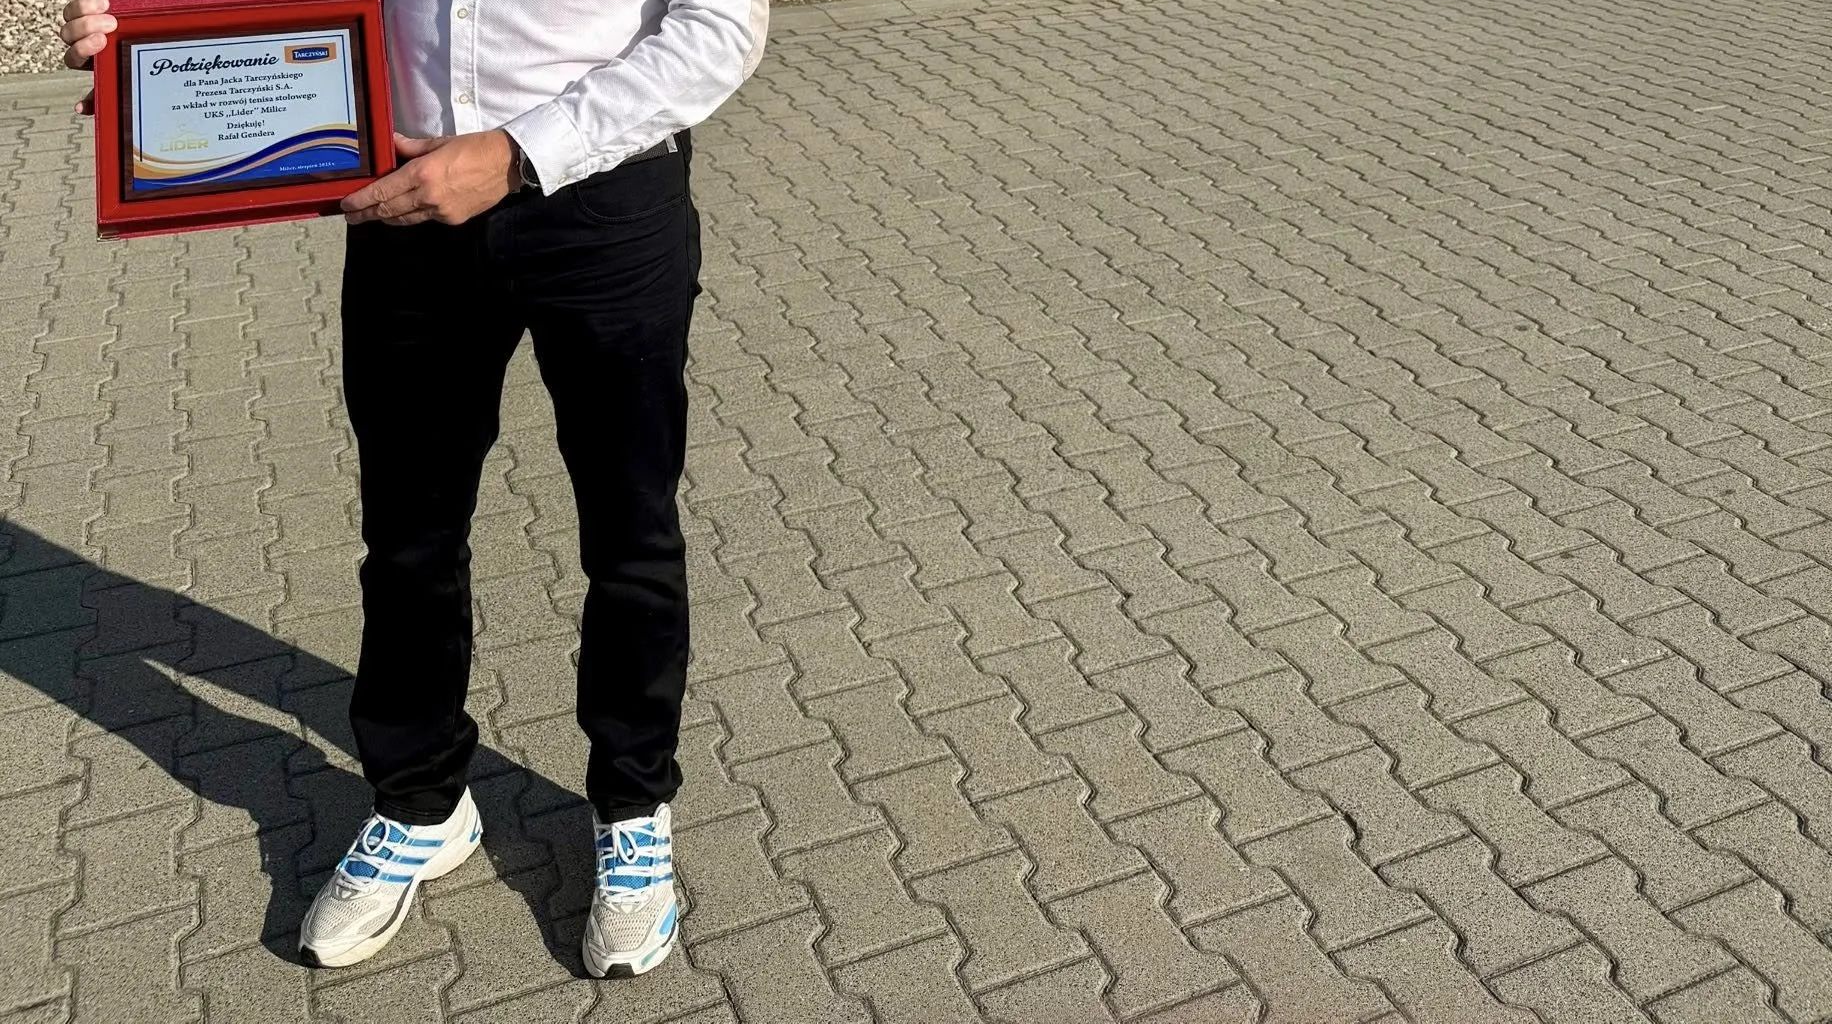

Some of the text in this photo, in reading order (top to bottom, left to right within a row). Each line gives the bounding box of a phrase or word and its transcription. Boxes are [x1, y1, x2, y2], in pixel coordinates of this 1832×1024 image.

[149, 52, 279, 76] Podziękowanie
[183, 72, 303, 87] dla Pana Jacka Tarczyńskiego
[195, 88, 227, 97] Prezesa
[228, 84, 274, 94] Tarczyński
[183, 100, 208, 109] wkład
[218, 97, 247, 106] rozwój
[249, 95, 273, 104] tenisa
[204, 110, 224, 118] UKS
[260, 105, 287, 114] Milicz
[227, 119, 265, 130] Dziękuję!
[218, 130, 275, 140] Rafał Gendera
